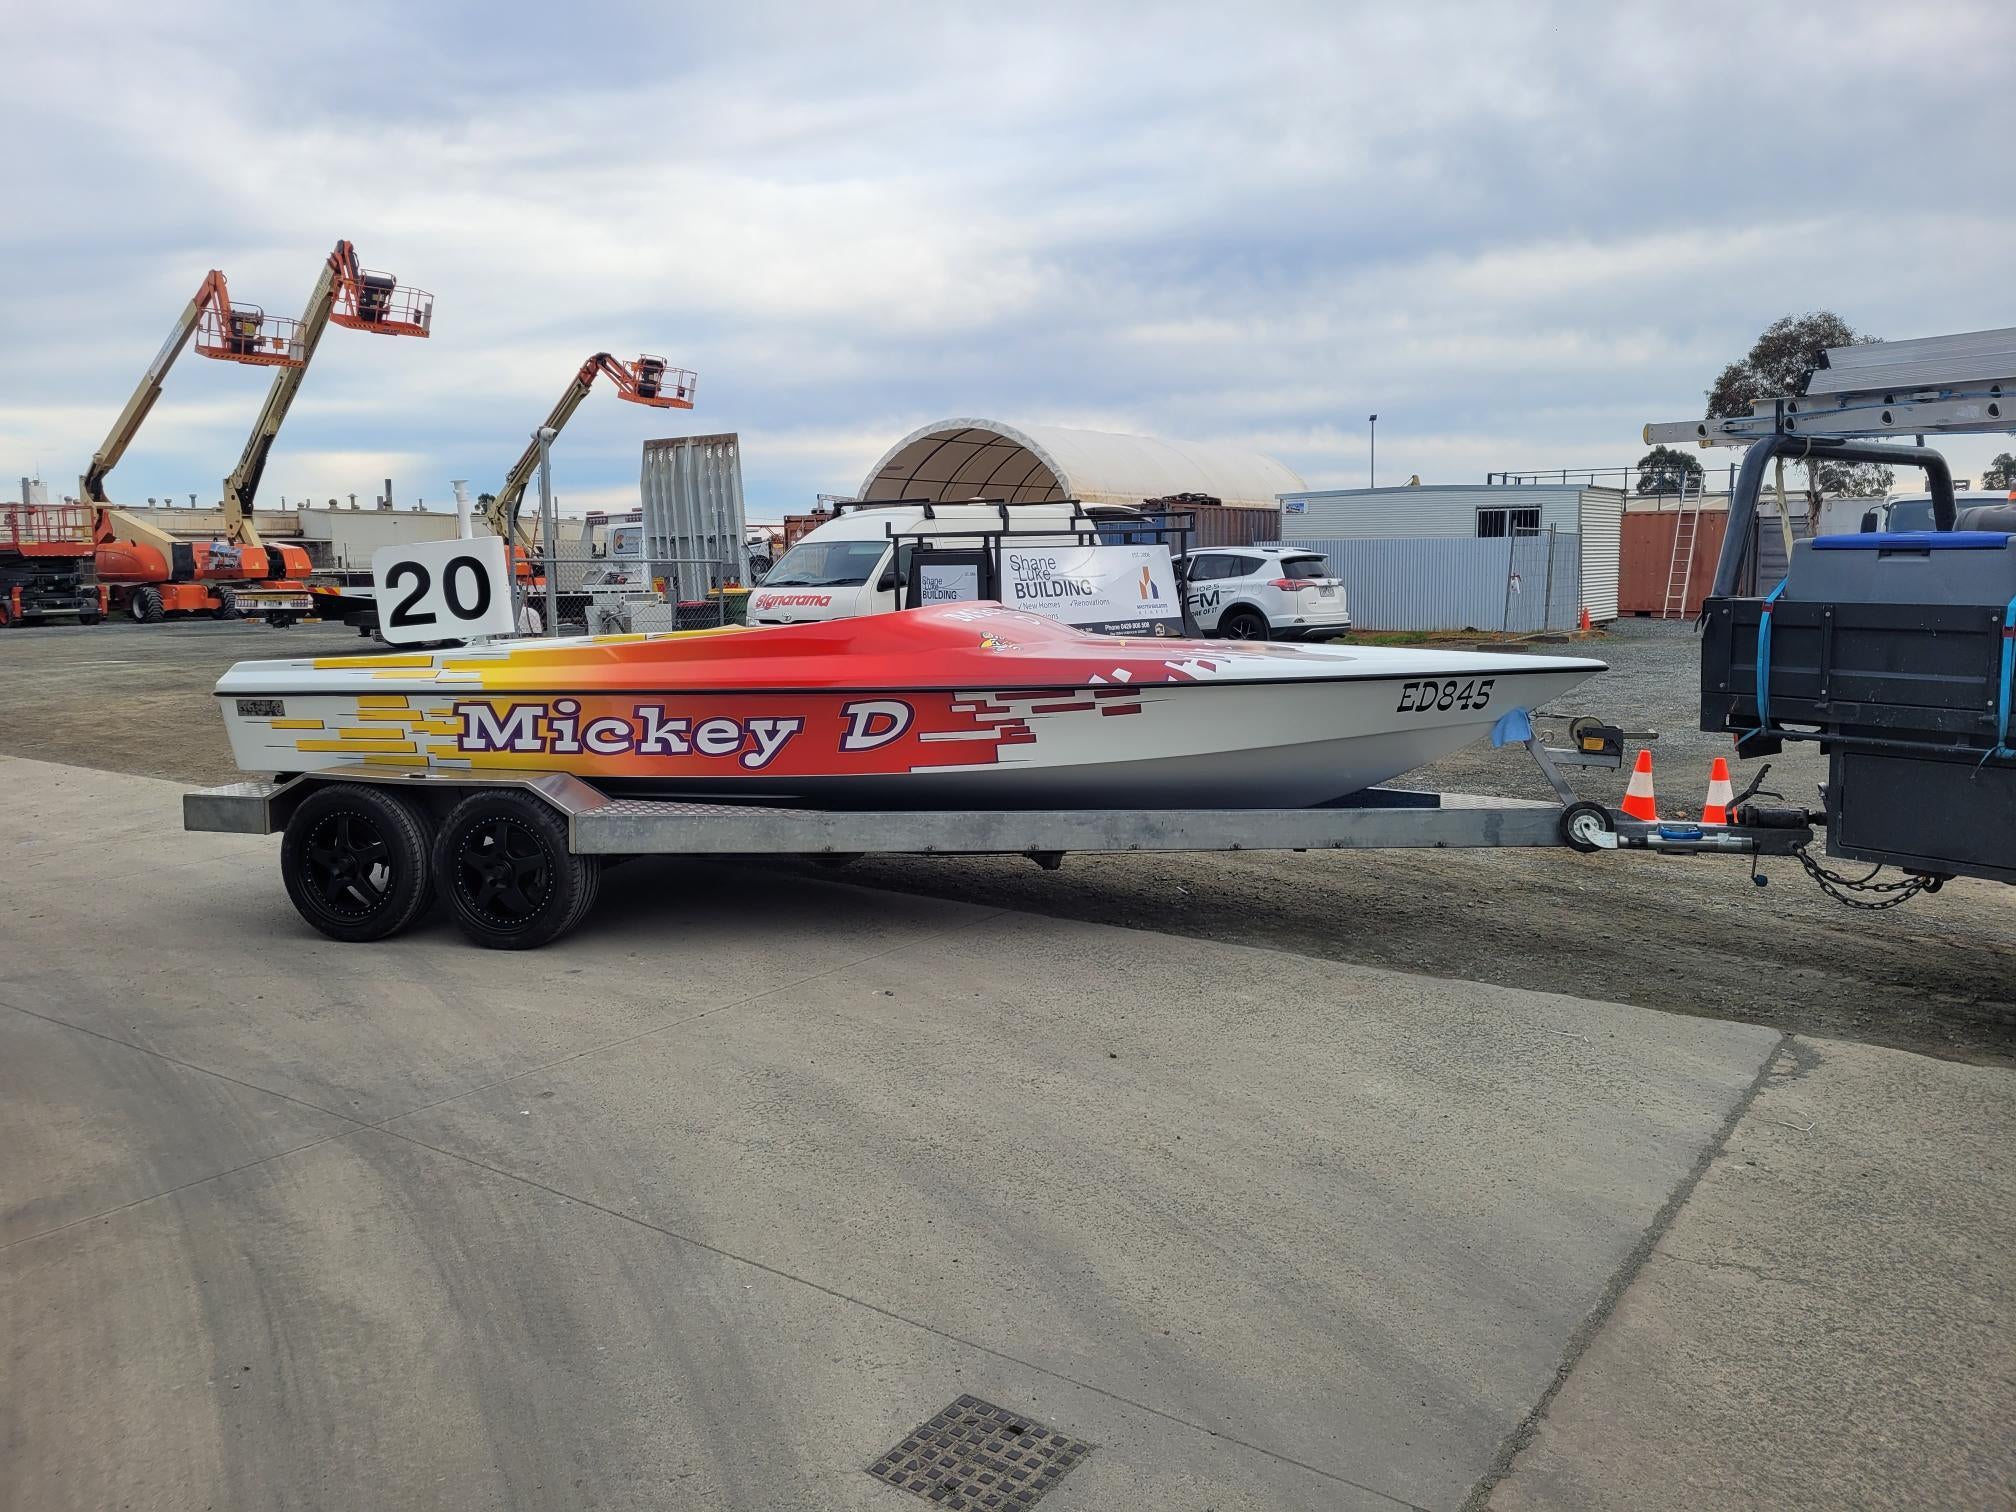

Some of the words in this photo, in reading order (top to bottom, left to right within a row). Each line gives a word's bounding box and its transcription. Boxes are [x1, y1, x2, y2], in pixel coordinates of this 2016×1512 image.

[1009, 553, 1056, 571] Shane
[922, 576, 942, 585] Shane
[1018, 568, 1051, 581] Luke
[385, 555, 491, 628] 20
[922, 590, 957, 600] BUILDING
[1014, 579, 1093, 599] BUILDING
[755, 594, 832, 611] Signarama
[1022, 602, 1038, 610] New
[1039, 601, 1060, 609] Homes
[1074, 599, 1110, 607] Renovations
[1396, 679, 1496, 712] ED845
[453, 696, 806, 770] Mickey
[837, 699, 917, 752] D
